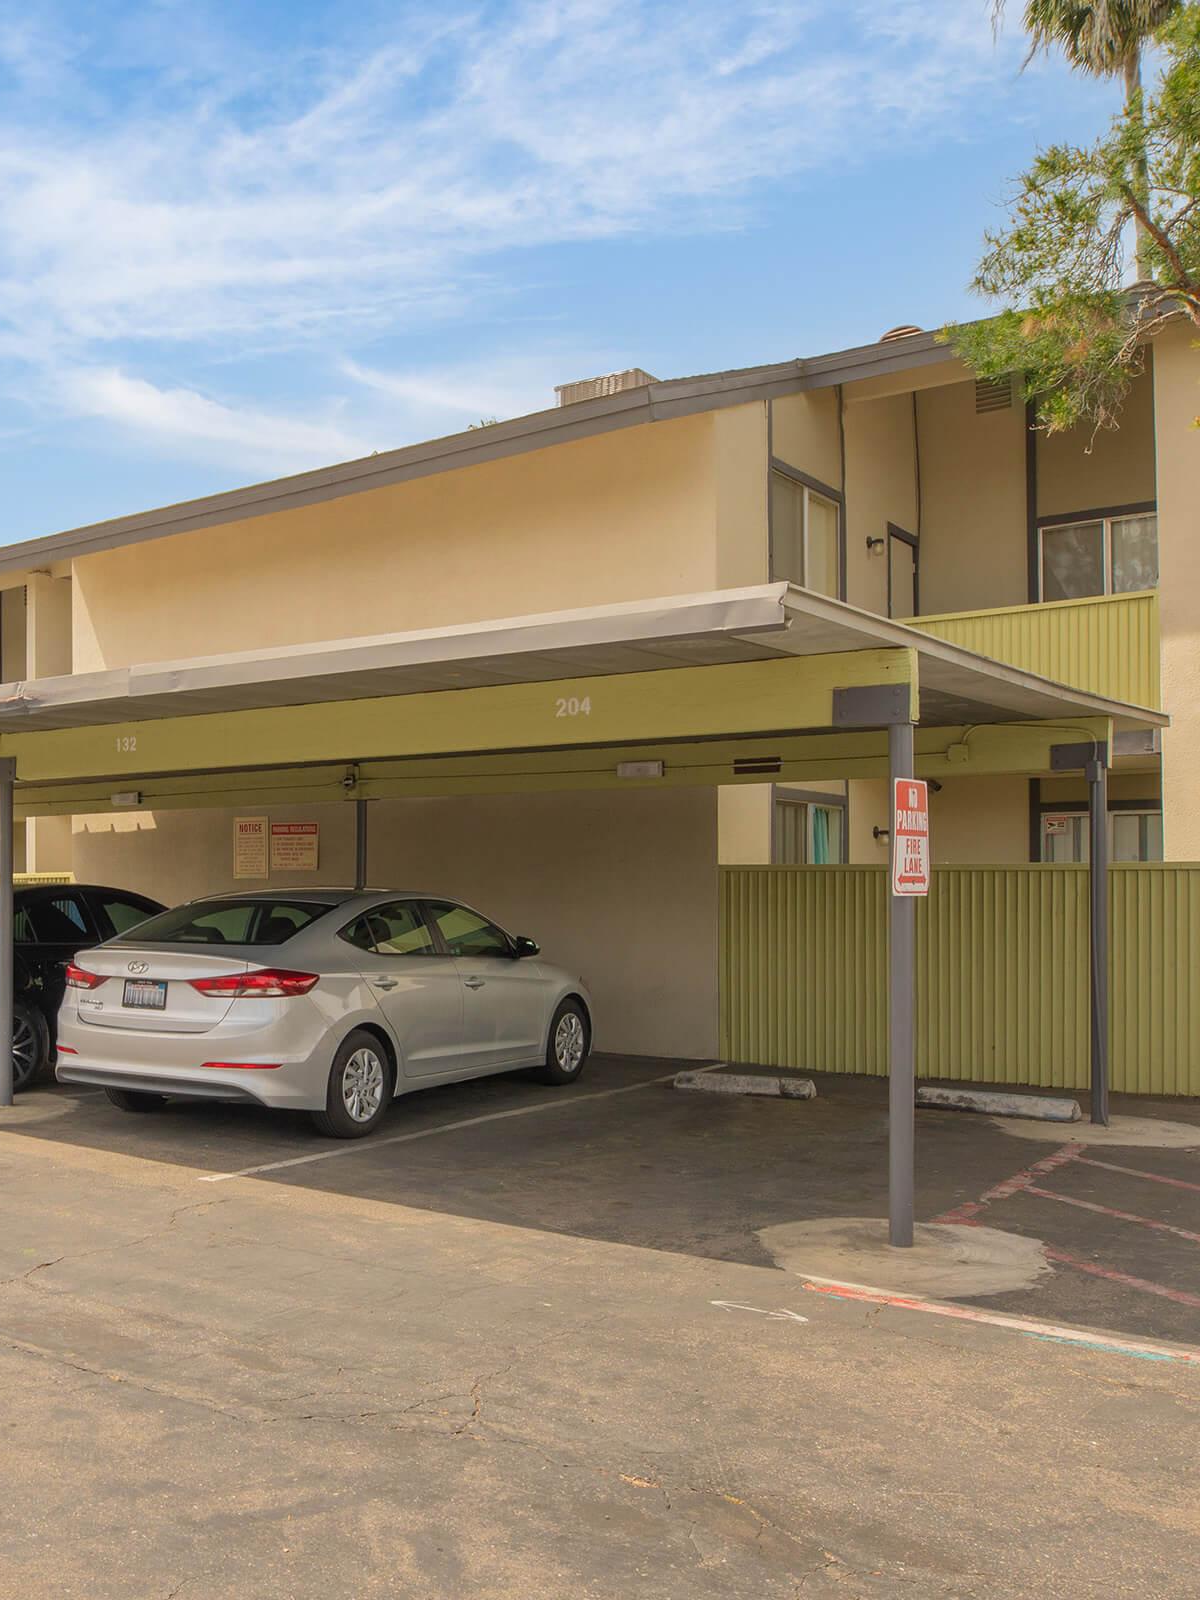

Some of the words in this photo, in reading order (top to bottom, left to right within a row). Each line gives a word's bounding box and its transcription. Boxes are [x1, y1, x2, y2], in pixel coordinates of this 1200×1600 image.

[555, 696, 591, 718] 204
[116, 736, 137, 752] 132
[908, 787, 918, 808] NO
[239, 823, 262, 833] NOTICE
[896, 809, 927, 832] PARKING
[906, 838, 921, 855] FIRE
[904, 856, 922, 874] LANE
